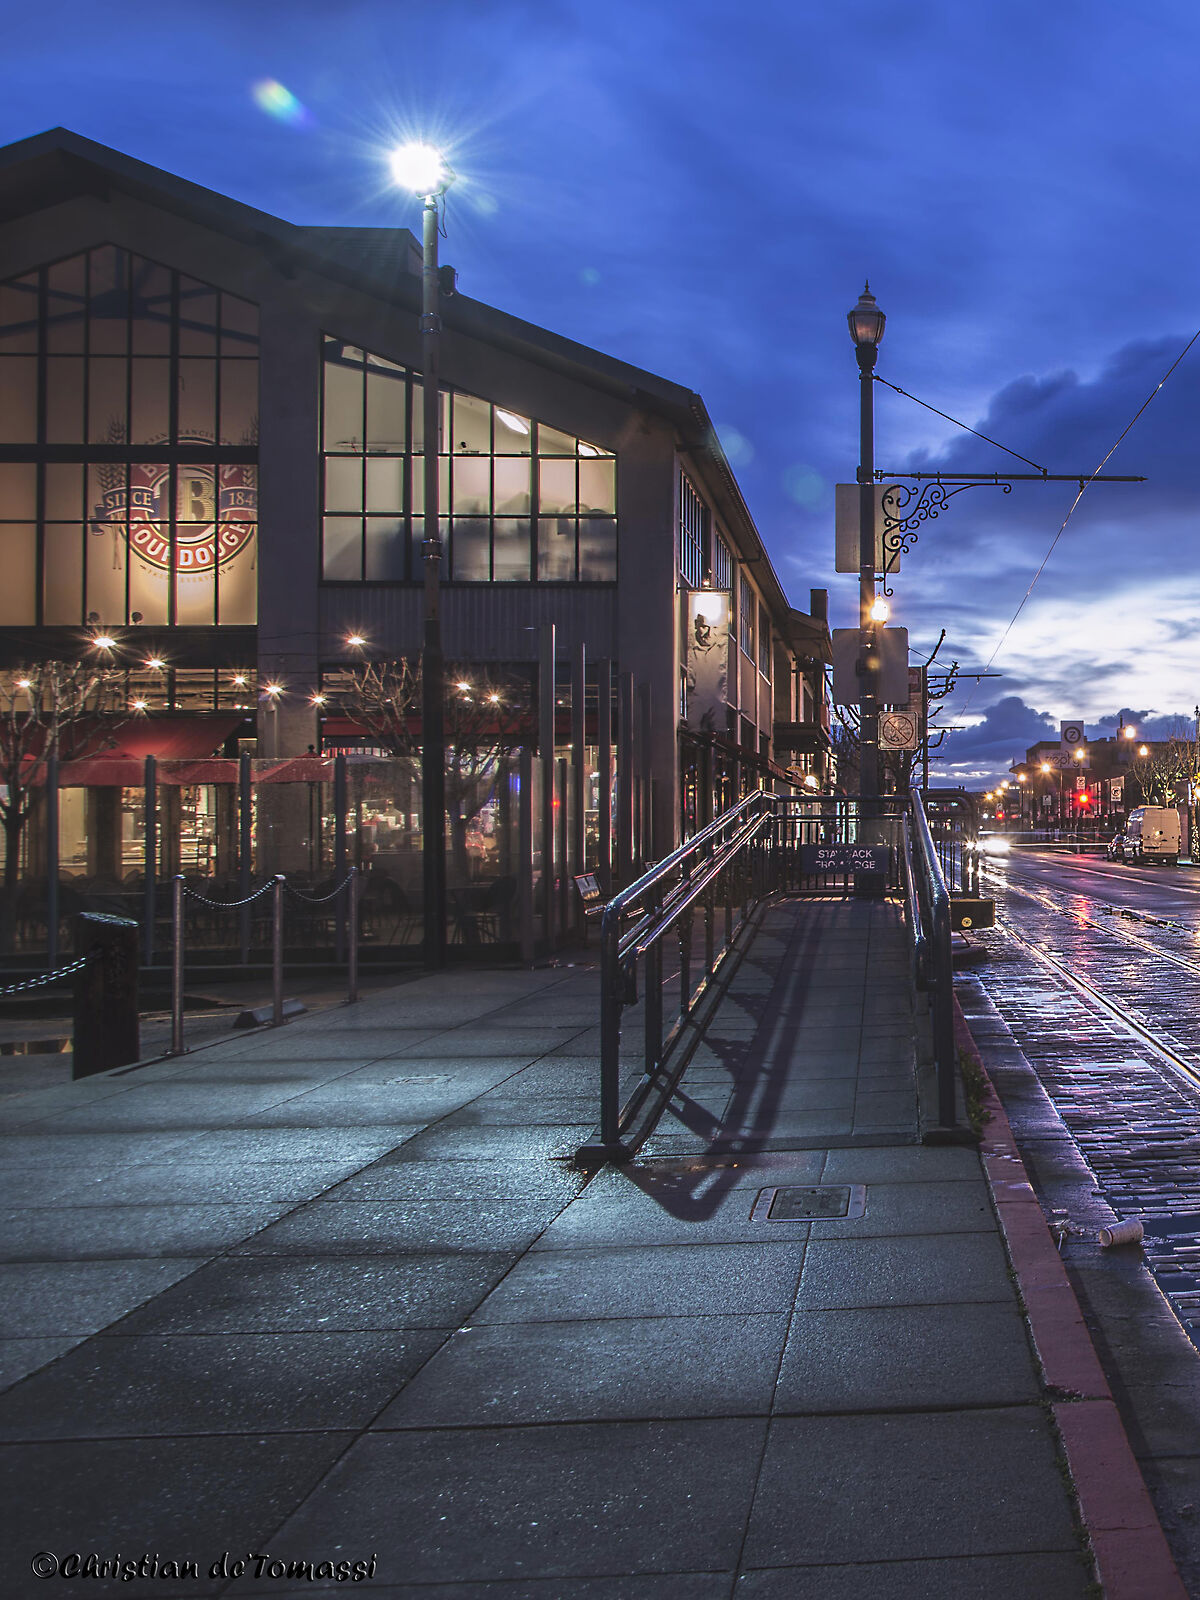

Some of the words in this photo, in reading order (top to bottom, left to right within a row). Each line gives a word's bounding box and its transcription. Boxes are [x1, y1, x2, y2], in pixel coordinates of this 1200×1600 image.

[229, 492, 255, 506] 184
[846, 849, 873, 859] ACK
[848, 860, 876, 870] DGE
